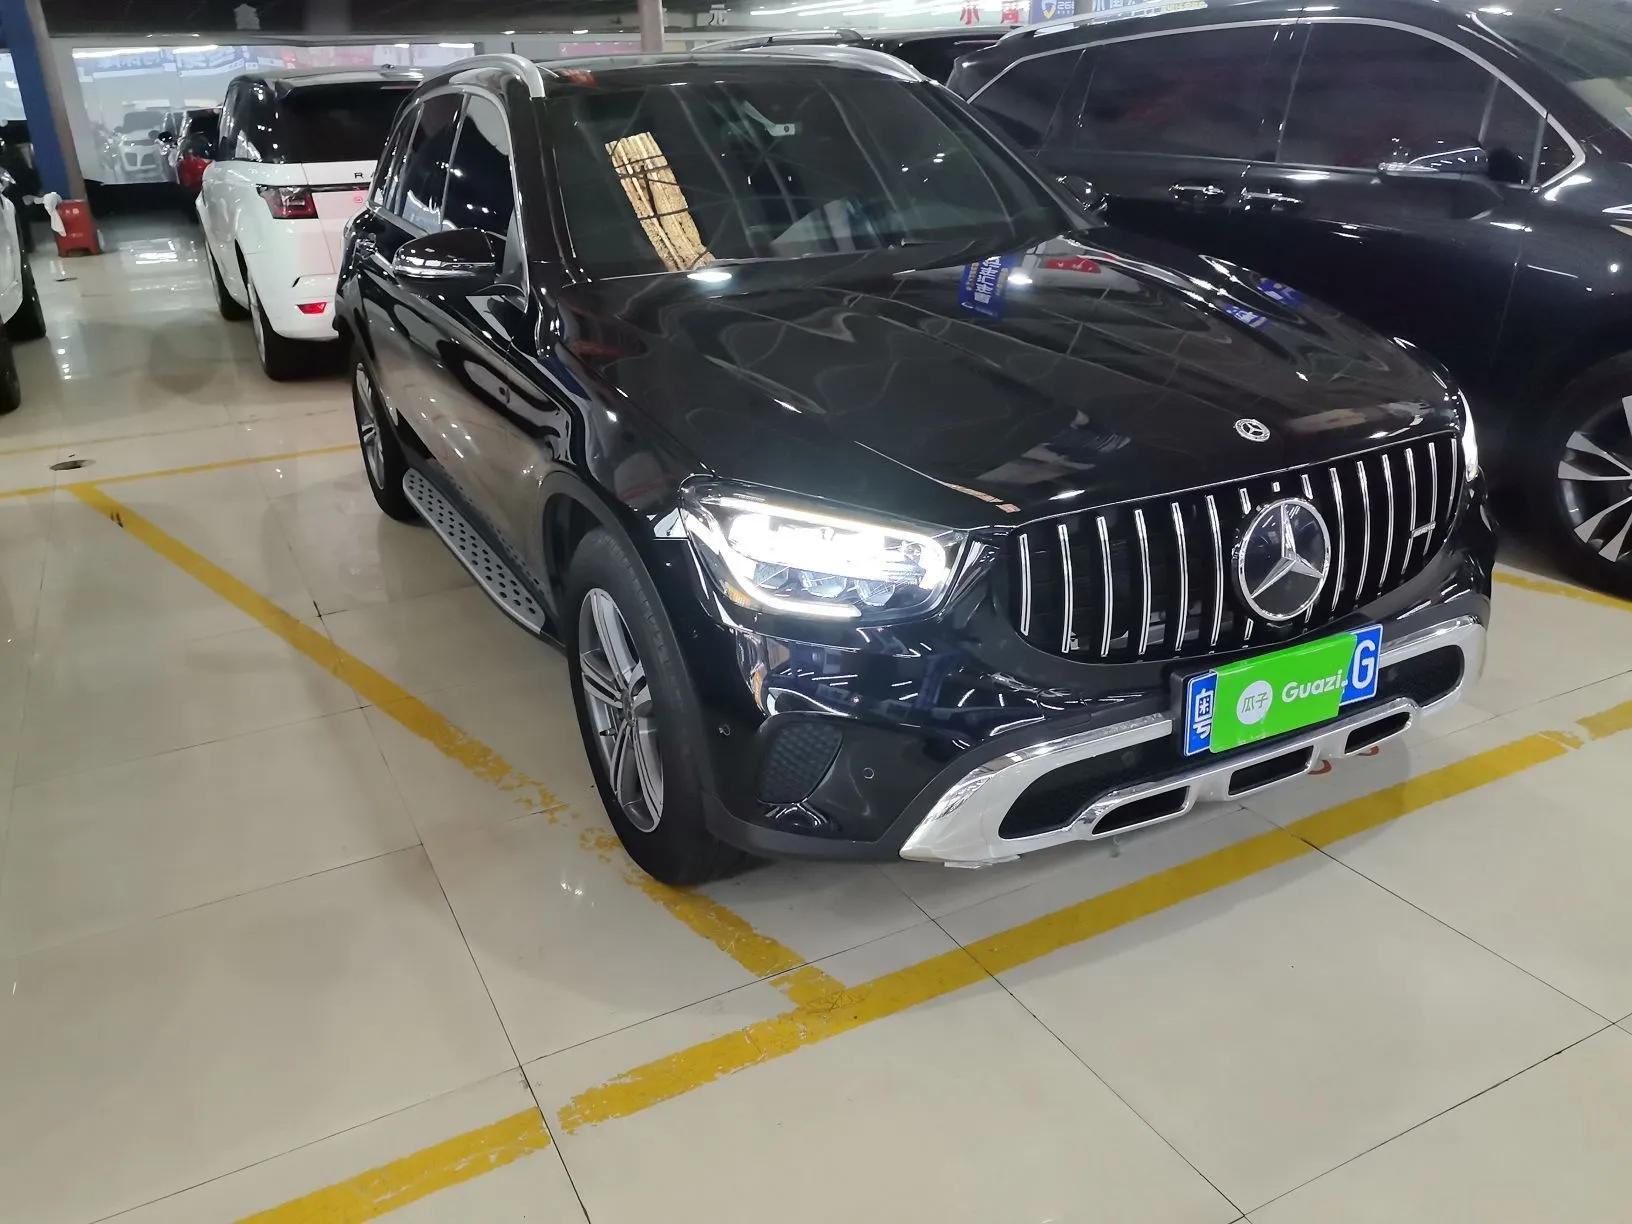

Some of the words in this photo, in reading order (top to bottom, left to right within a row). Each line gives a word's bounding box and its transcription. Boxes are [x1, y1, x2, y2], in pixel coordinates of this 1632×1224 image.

[1352, 639, 1376, 689] G
[1192, 688, 1214, 739] 粤
[1241, 691, 1269, 713] 瓜子
